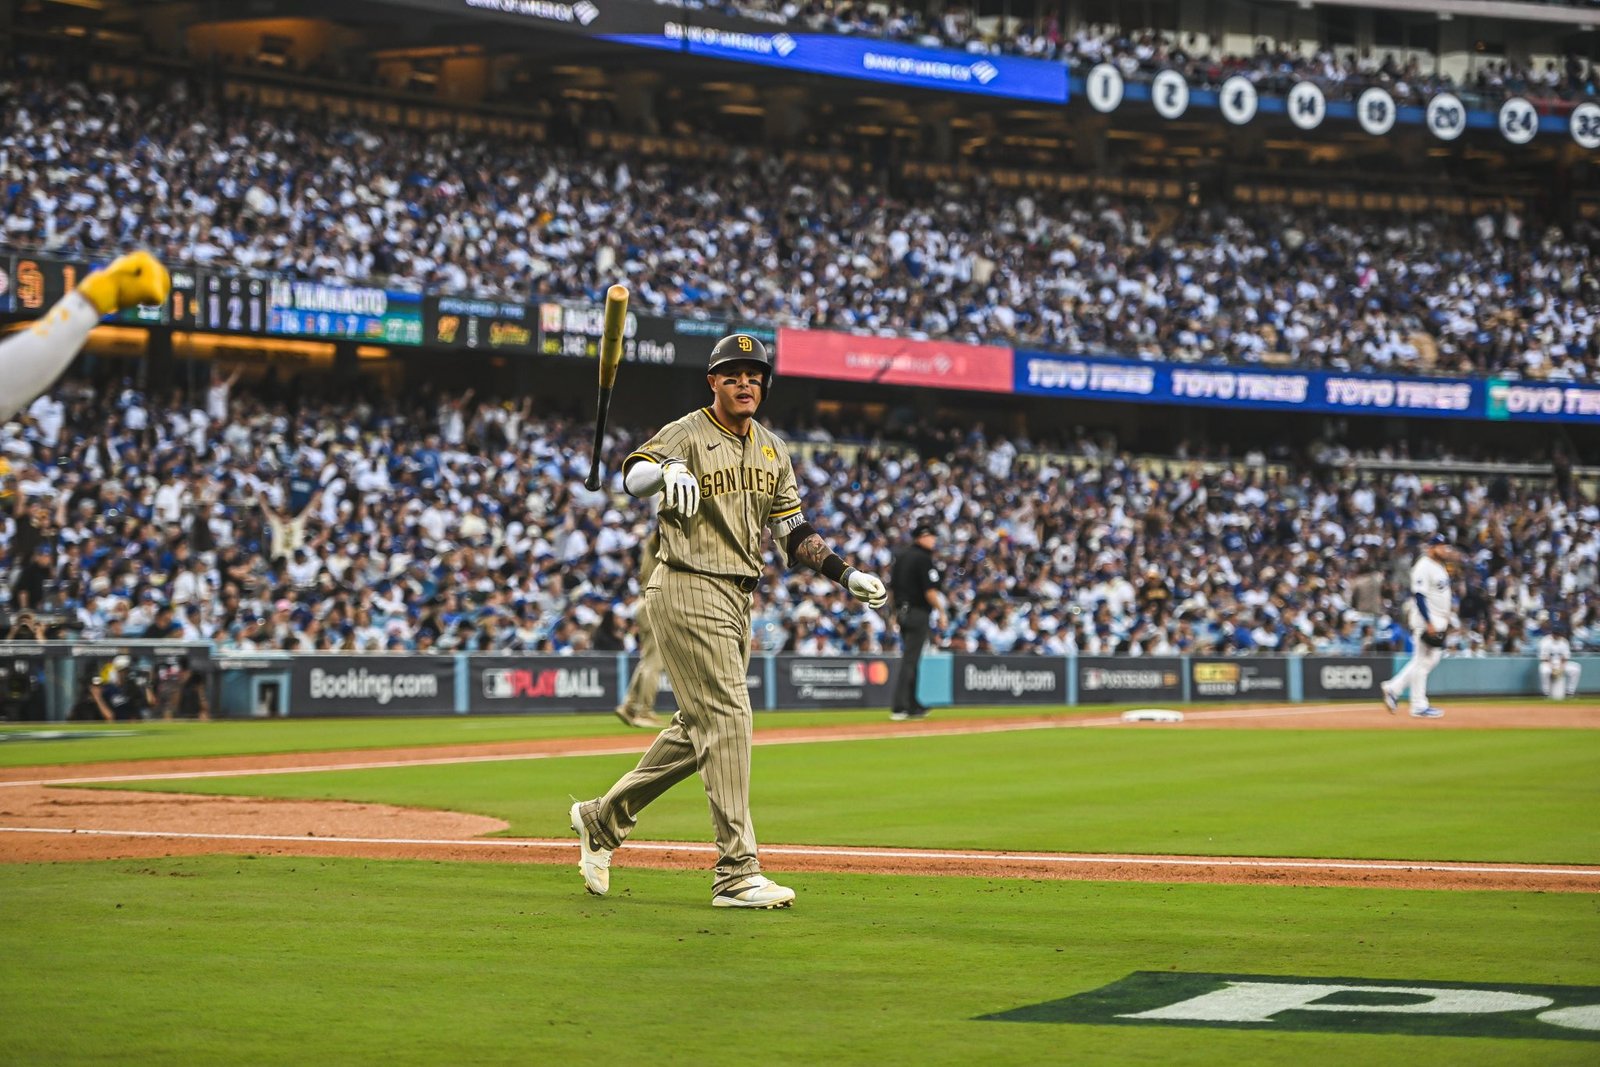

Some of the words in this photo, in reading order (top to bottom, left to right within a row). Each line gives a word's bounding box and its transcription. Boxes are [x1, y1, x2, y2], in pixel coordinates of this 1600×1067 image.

[1101, 75, 1111, 99] 1
[1164, 83, 1177, 107] 2
[1231, 90, 1244, 111] 4
[1297, 96, 1316, 116] 14
[1434, 106, 1459, 129] 20
[1505, 110, 1532, 133] 24
[1171, 369, 1235, 400] TOYO
[1325, 377, 1395, 408] TOYO
[1489, 385, 1563, 415] TOYO
[700, 467, 737, 499] SAN
[310, 667, 438, 704] Booking.com
[964, 663, 1056, 697] Booking.com
[1321, 665, 1373, 690] GEICO
